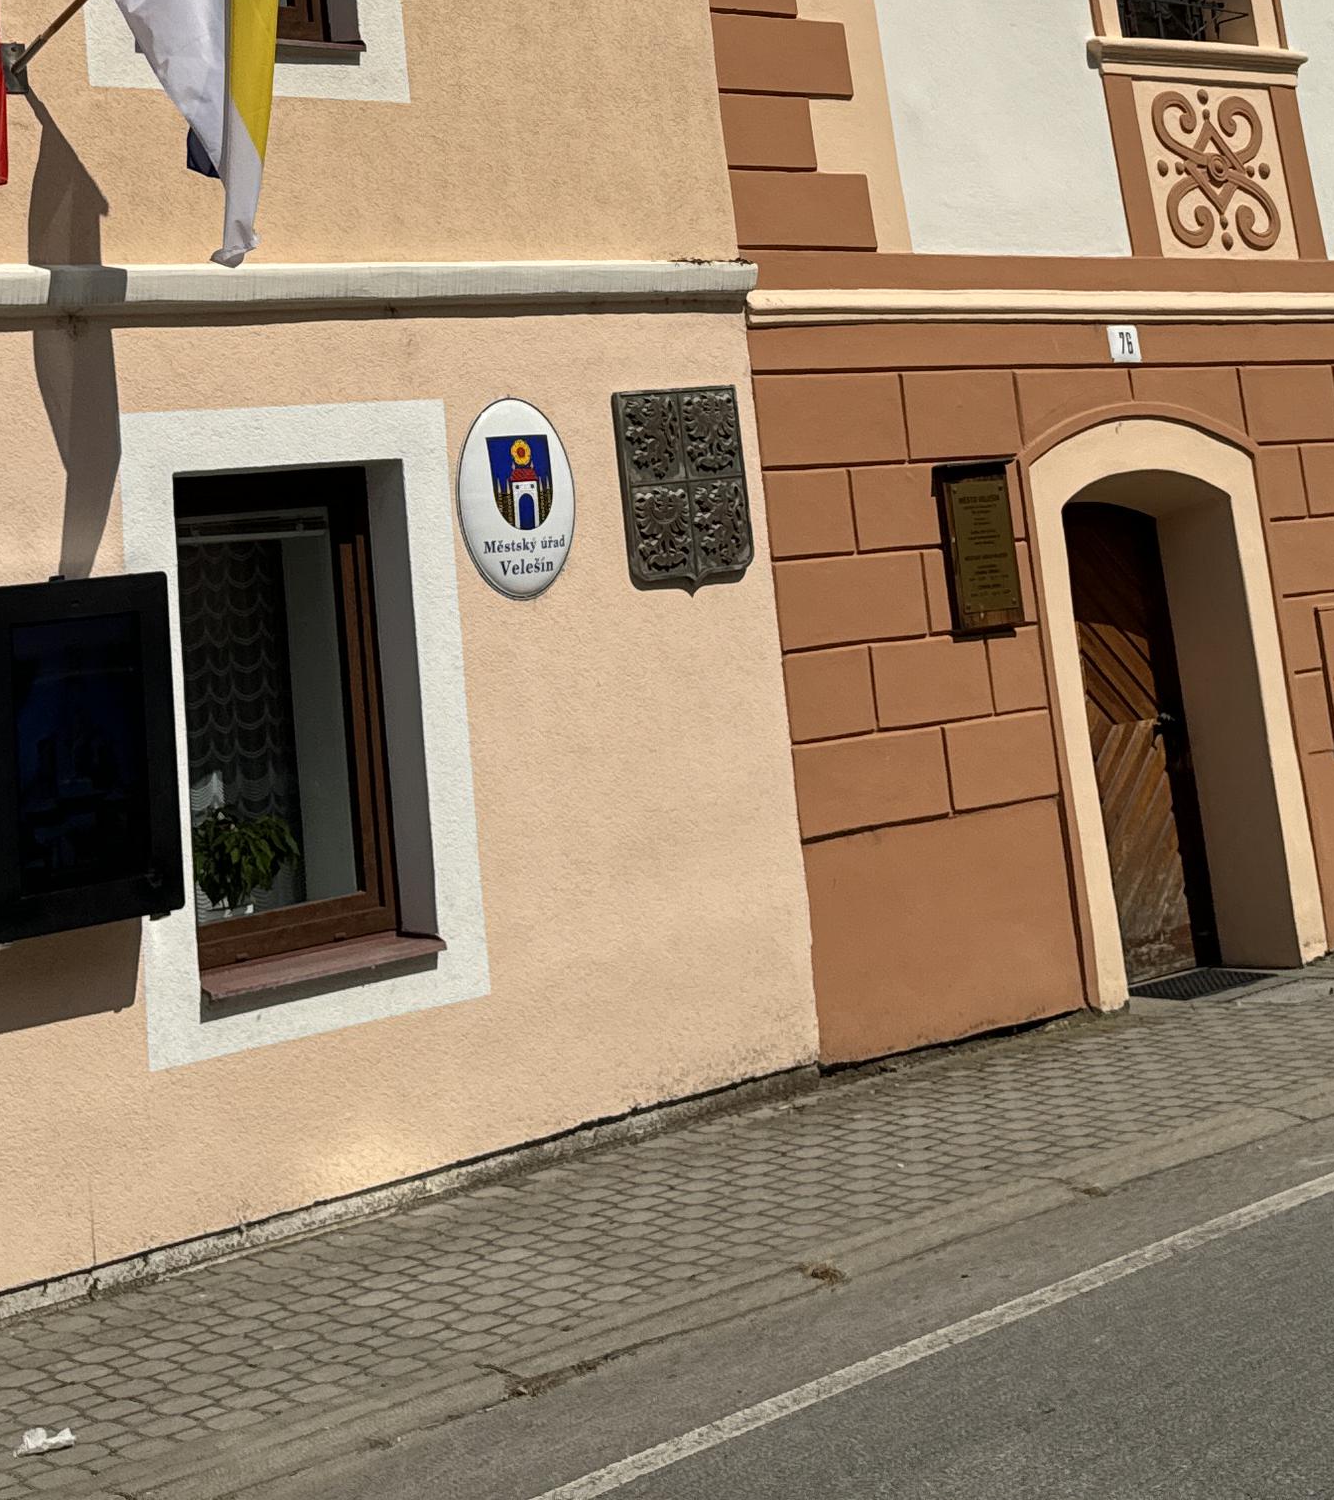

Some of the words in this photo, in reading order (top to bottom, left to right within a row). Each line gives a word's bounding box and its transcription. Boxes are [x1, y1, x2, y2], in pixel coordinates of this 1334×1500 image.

[1118, 331, 1134, 354] 76
[483, 537, 536, 554] Městský
[541, 535, 565, 549] úřad
[499, 557, 554, 576] Velešín
